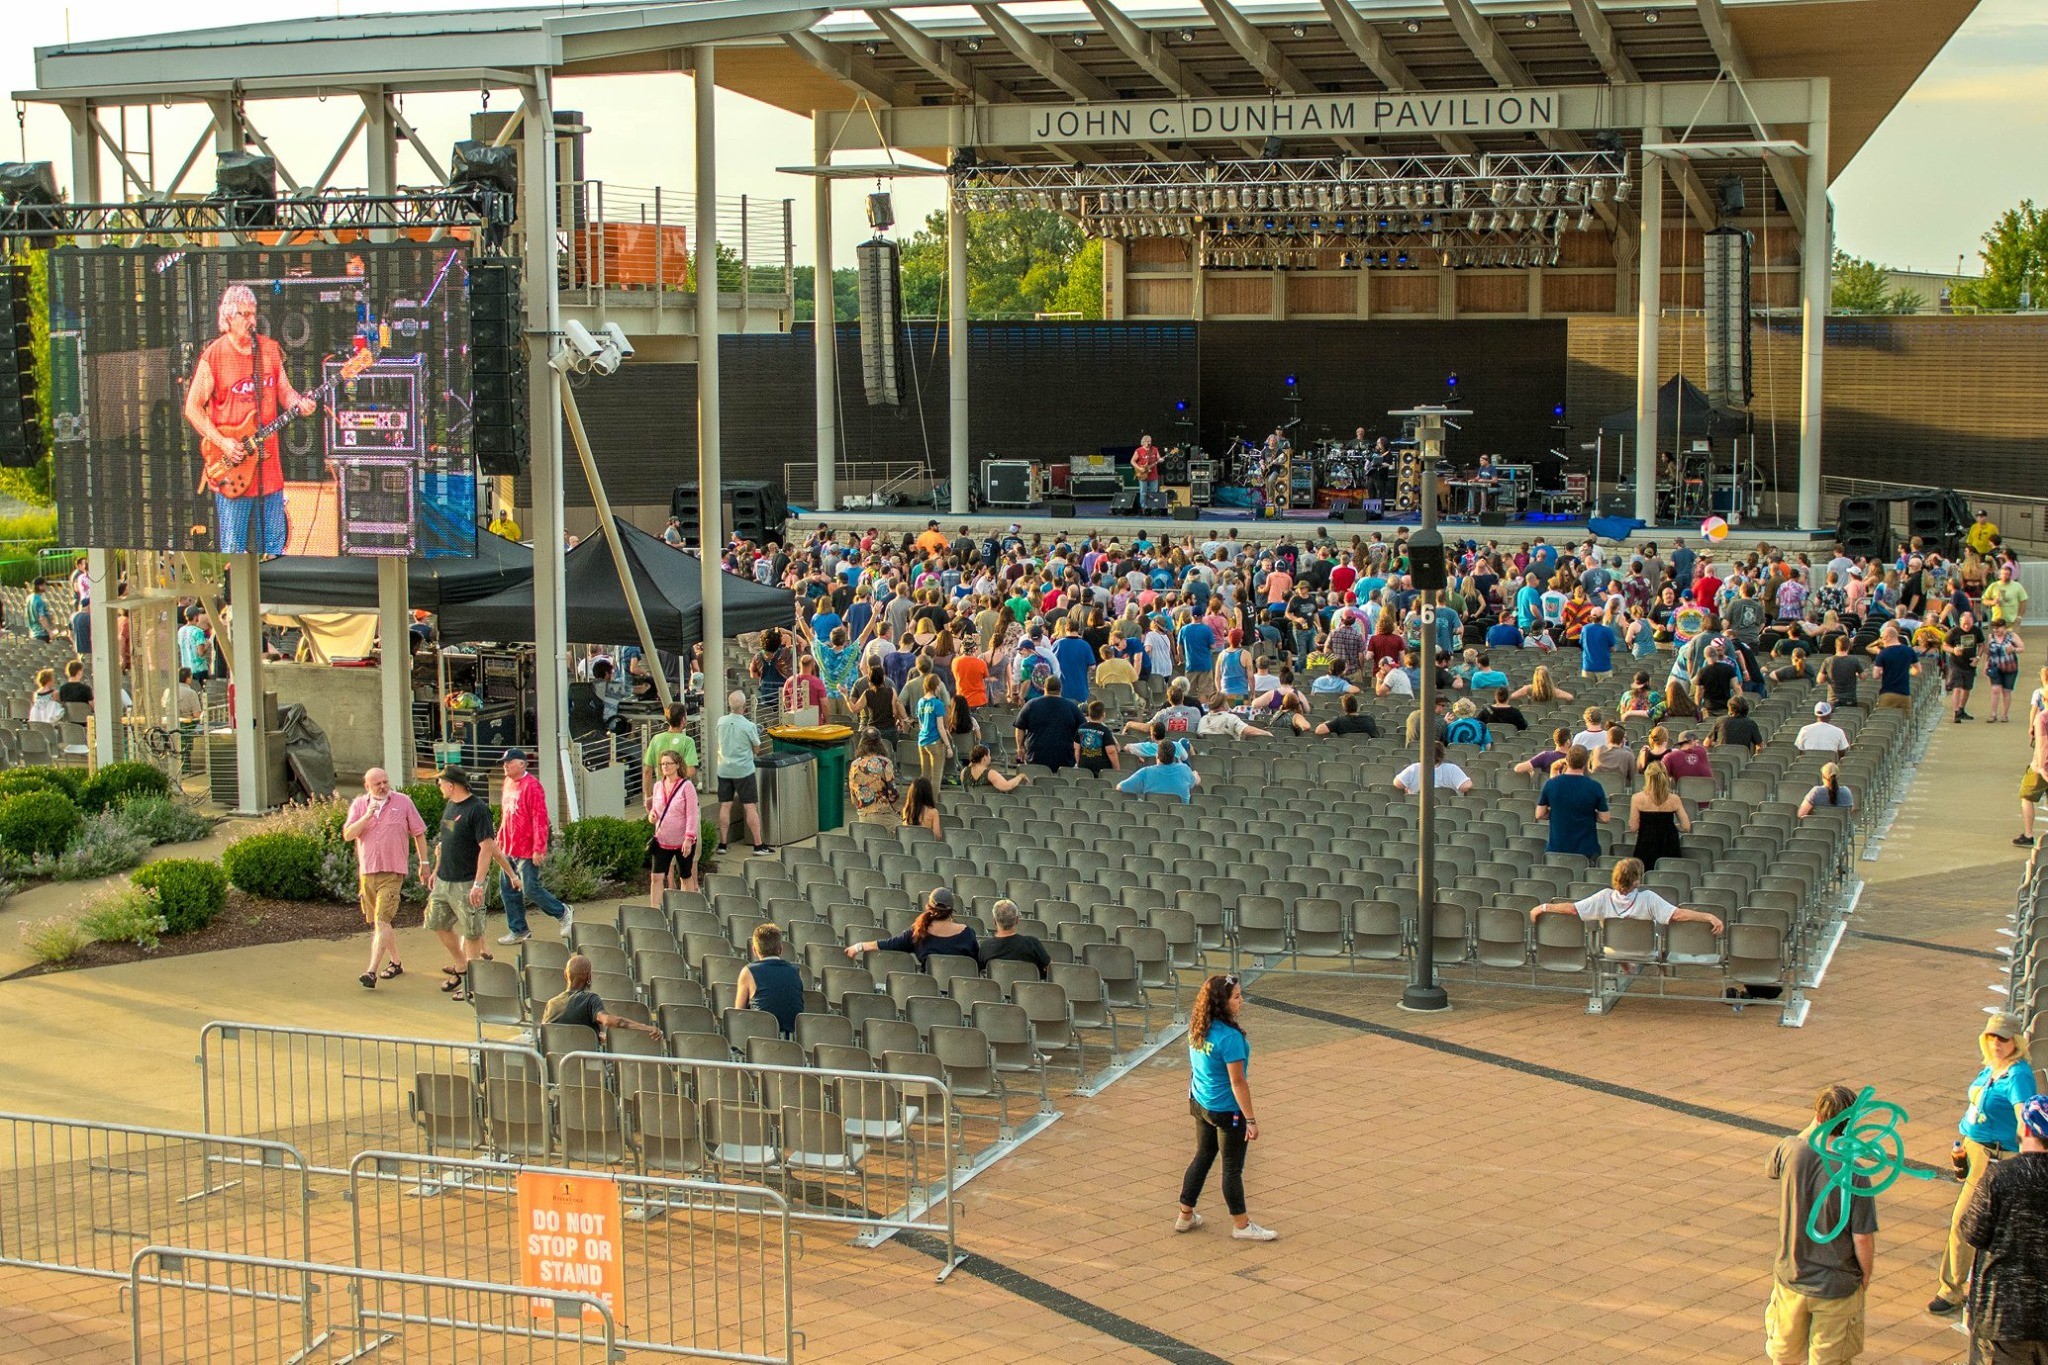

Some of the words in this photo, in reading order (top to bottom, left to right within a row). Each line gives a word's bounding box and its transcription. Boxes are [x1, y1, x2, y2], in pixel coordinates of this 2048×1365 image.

[1037, 109, 1131, 137] JOHN
[1149, 108, 1175, 134] C.
[1192, 102, 1354, 133] DUNHAM
[1374, 96, 1551, 128] PAVILION
[1421, 603, 1435, 624] 6
[532, 1209, 560, 1232] DO
[566, 1212, 606, 1236] NOT
[528, 1233, 579, 1258] STOP
[585, 1238, 613, 1262] OR
[540, 1260, 603, 1286] STAND
